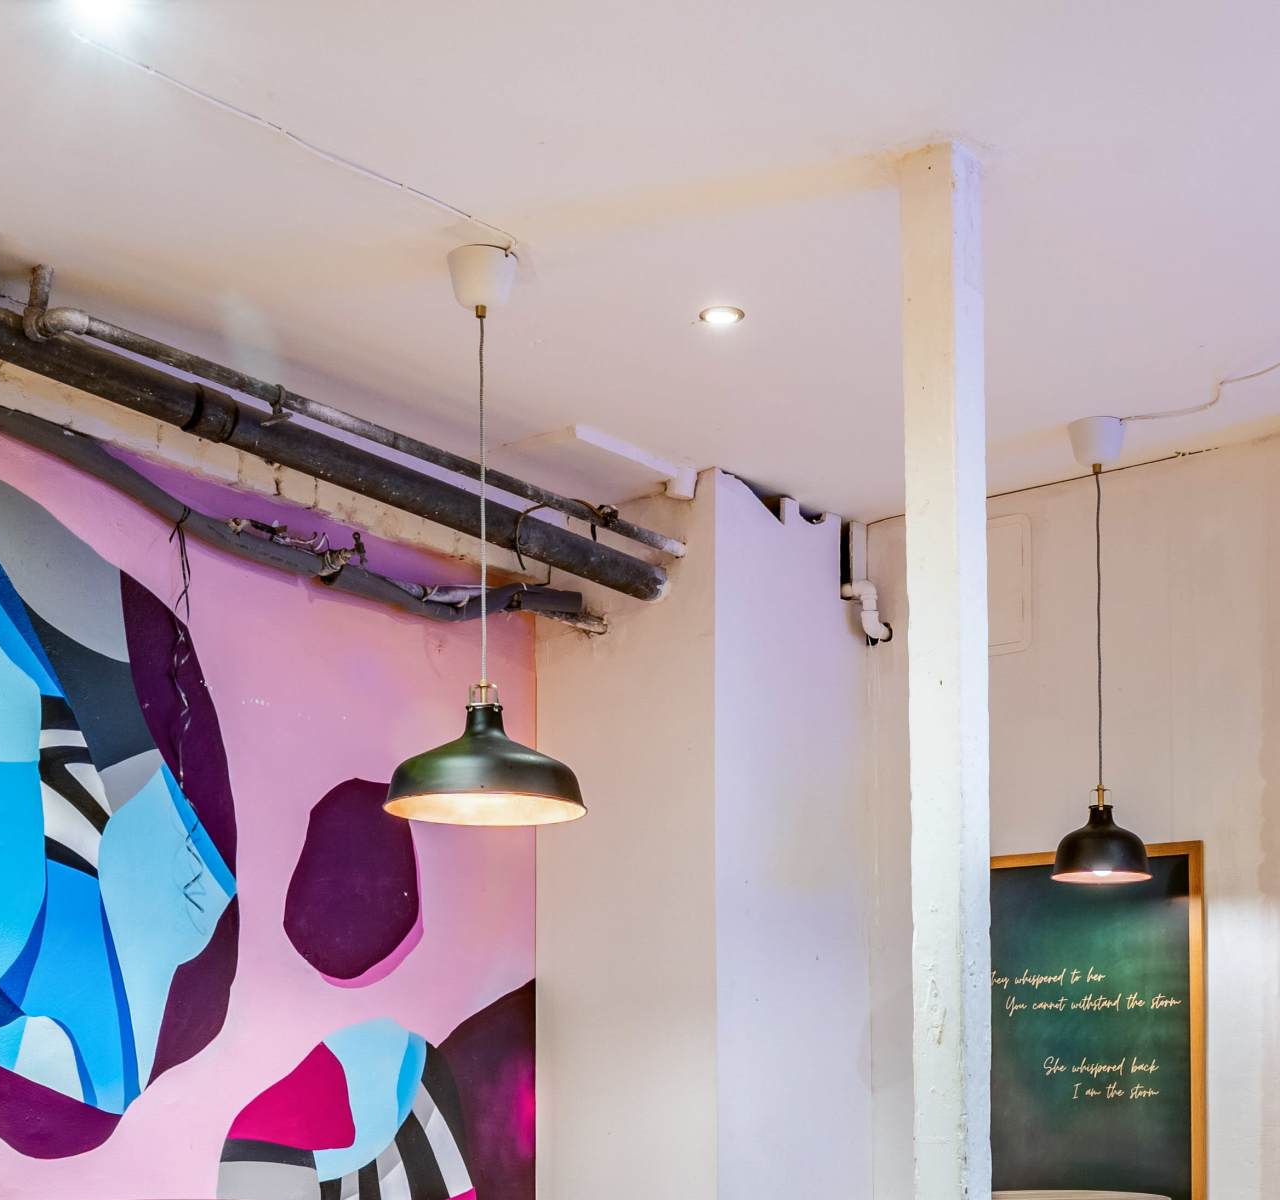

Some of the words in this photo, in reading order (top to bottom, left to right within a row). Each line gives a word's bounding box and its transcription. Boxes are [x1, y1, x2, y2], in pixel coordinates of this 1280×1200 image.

[990, 970, 1009, 990] hey
[1015, 968, 1066, 990] whispered
[1070, 969, 1082, 985] to
[1086, 966, 1107, 984] her
[1005, 996, 1027, 1016] You
[1032, 996, 1068, 1011] cannot
[1071, 993, 1122, 1012] withstand
[1126, 992, 1145, 1009] the
[1150, 993, 1184, 1011] storm
[1043, 1056, 1067, 1076] She
[1072, 1057, 1126, 1078] whispered
[1131, 1056, 1160, 1074] back
[1072, 1083, 1083, 1099] I
[1085, 1088, 1102, 1096] am
[1106, 1081, 1124, 1099] the
[1129, 1083, 1160, 1099] storm
